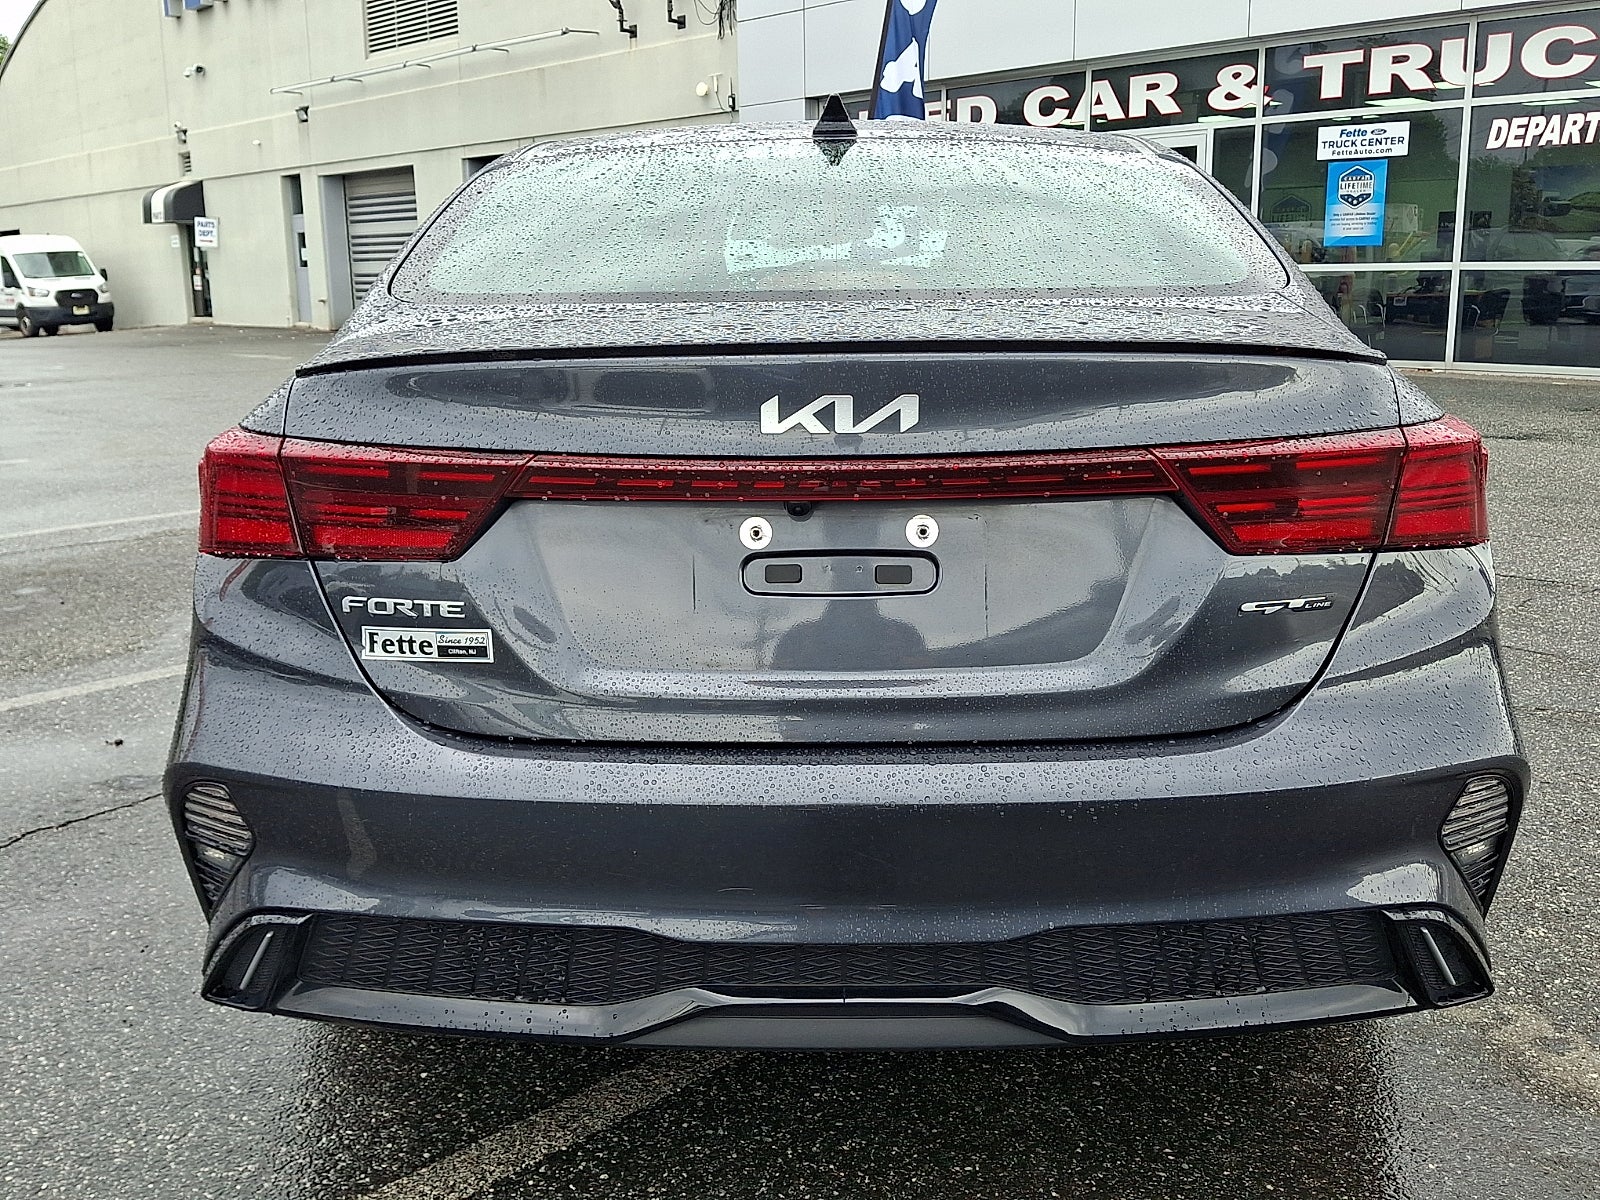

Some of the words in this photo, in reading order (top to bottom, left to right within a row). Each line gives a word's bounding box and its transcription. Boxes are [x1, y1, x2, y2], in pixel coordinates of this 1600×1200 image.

[1022, 71, 1182, 127] CAR
[1206, 63, 1273, 112] &
[1339, 127, 1368, 139] Fette
[1321, 139, 1358, 150] TRUCK
[1360, 136, 1405, 147] CENTER
[1331, 147, 1393, 157] FetteAuto.com
[1340, 181, 1373, 190] LIFETIME
[197, 220, 215, 229] PARTS
[760, 394, 919, 434] KIA
[342, 595, 466, 619] FORTE
[1304, 601, 1332, 609] LINE
[367, 631, 434, 656] Fette
[437, 634, 462, 645] Since
[464, 636, 486, 645] 1952
